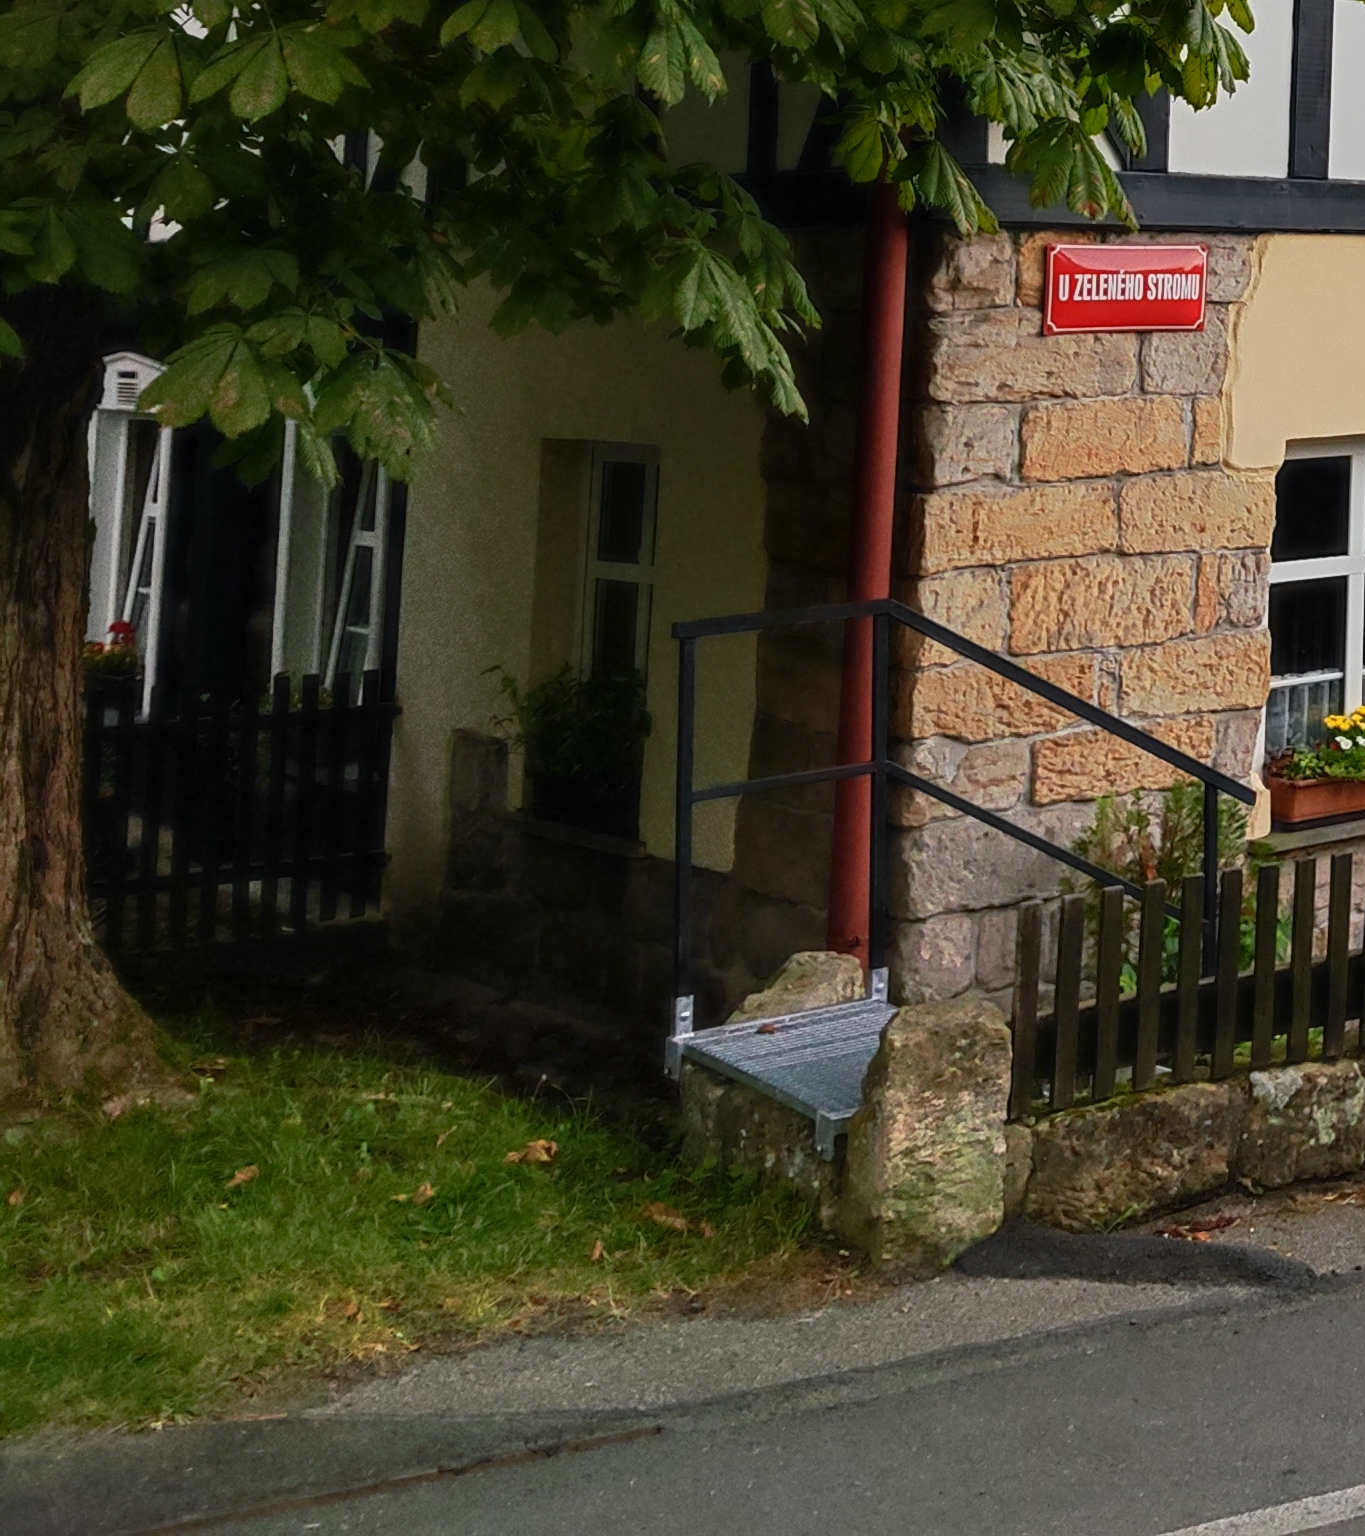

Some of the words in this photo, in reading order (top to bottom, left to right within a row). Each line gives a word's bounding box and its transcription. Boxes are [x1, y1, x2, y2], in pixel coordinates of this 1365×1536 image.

[1058, 273, 1070, 301] U
[1073, 269, 1144, 301] ZELENÉHO
[1146, 273, 1200, 301] STROMU
